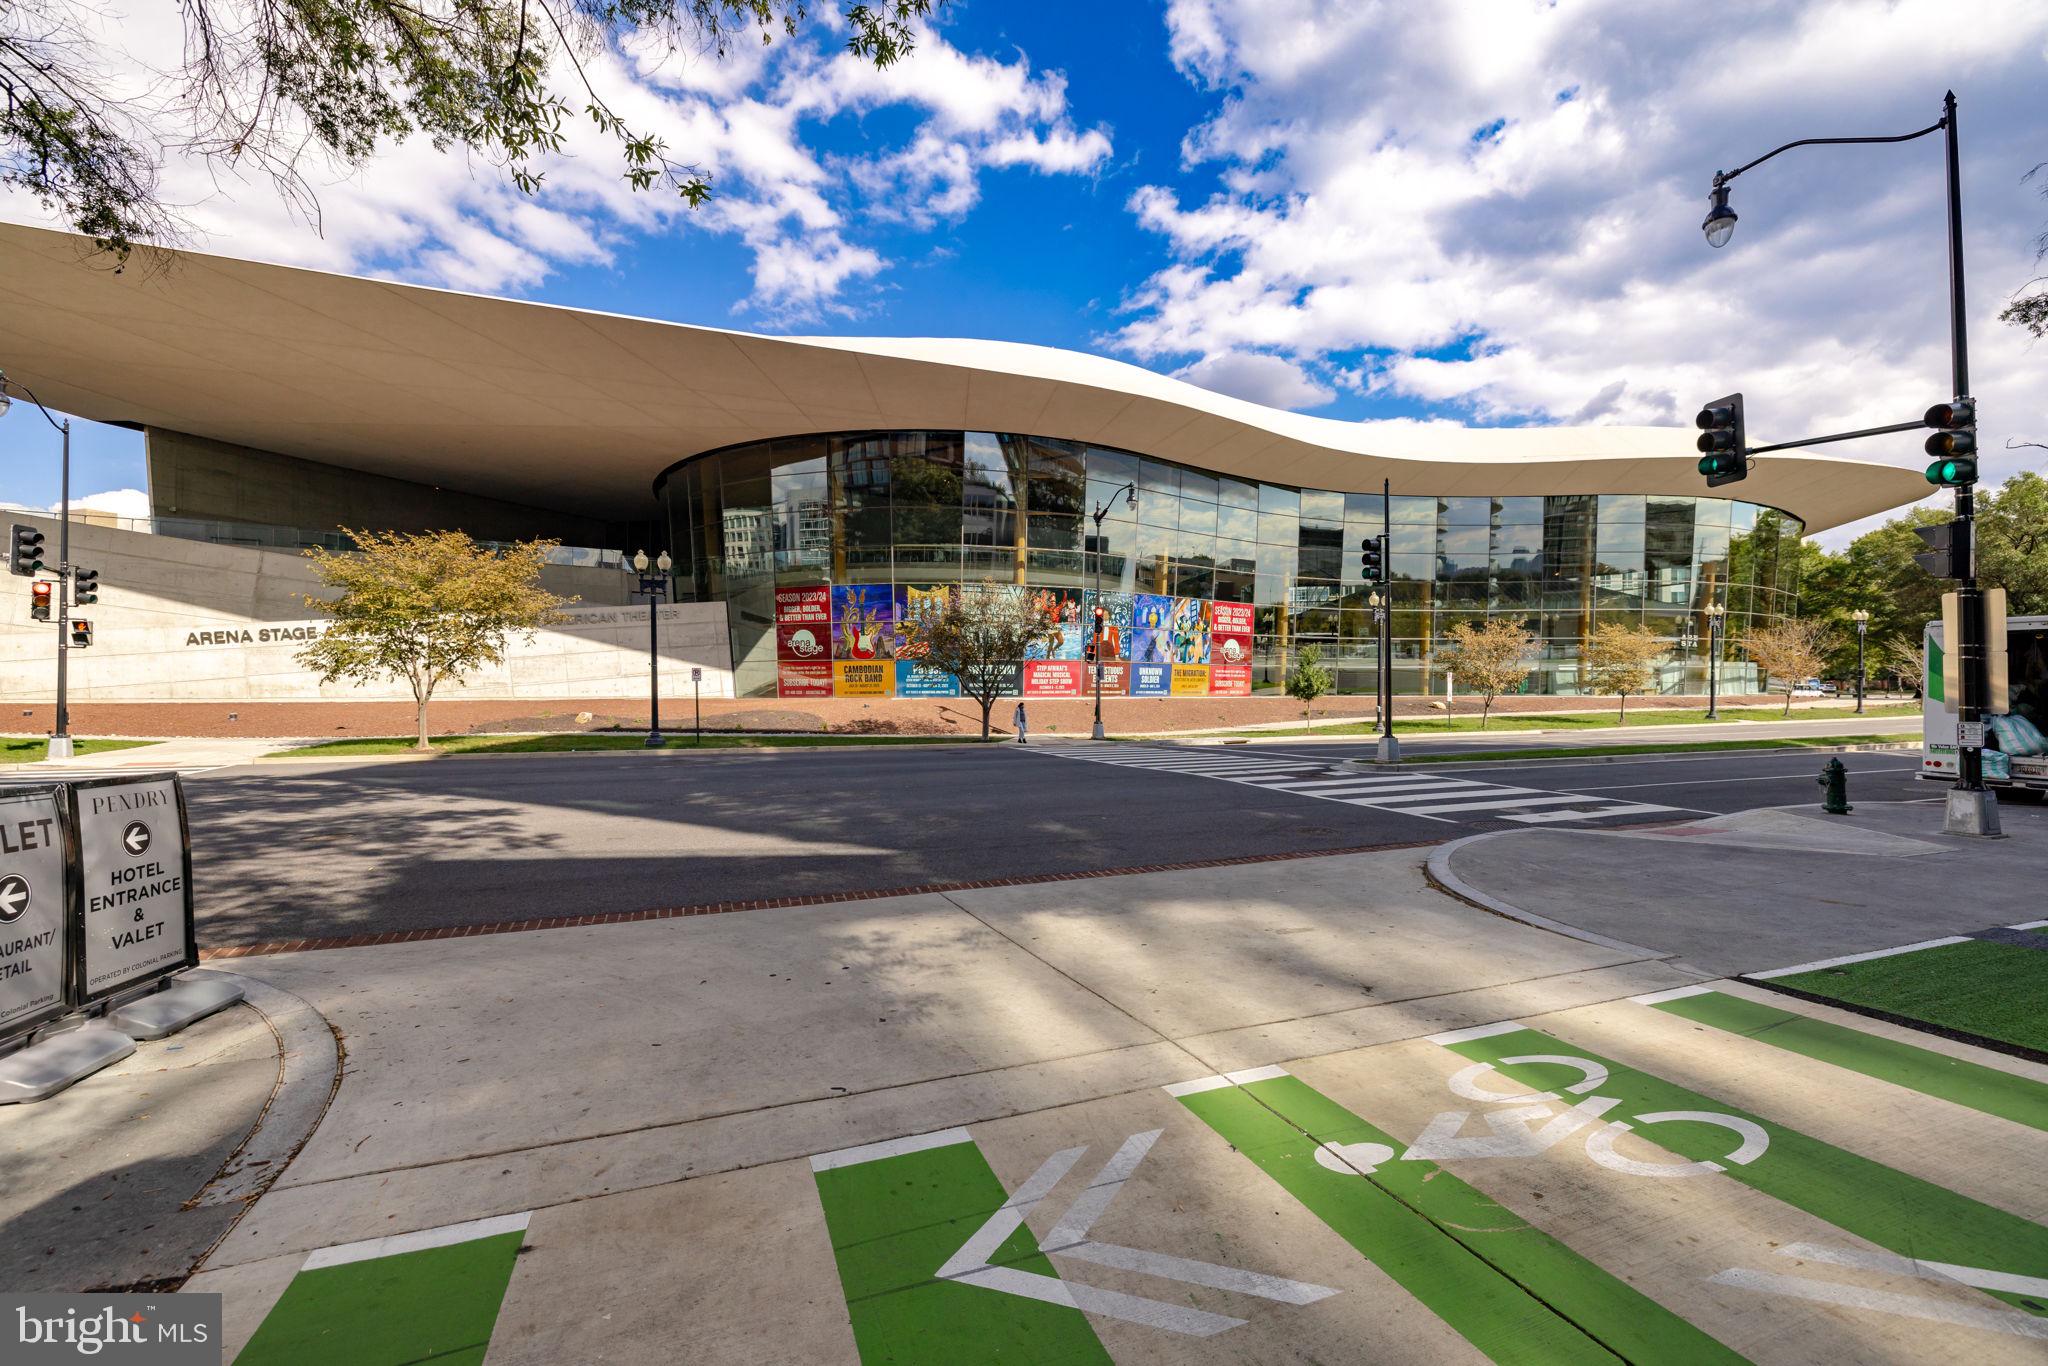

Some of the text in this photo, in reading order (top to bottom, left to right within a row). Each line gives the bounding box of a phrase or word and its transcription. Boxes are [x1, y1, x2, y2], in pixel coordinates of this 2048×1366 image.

[778, 591, 827, 602] SEASON 2023/24
[622, 610, 680, 622] THETER
[802, 613, 815, 621] THAN
[186, 629, 253, 646] ARENA
[258, 626, 318, 643] STAGE
[787, 639, 811, 647] arena
[800, 644, 823, 655] stage
[843, 665, 884, 674] CAMBODIAN
[845, 674, 883, 683] ROCK BAND
[92, 789, 169, 815] PENDRY
[0, 818, 53, 855] LET
[111, 861, 165, 886] HOTEL
[90, 877, 181, 913] ENTRANCE
[133, 907, 145, 922] &
[111, 921, 165, 950] VALET
[89, 949, 183, 986] OPERATED BY COLONIAL PARKING
[0, 993, 54, 1018] Colonial Parking
